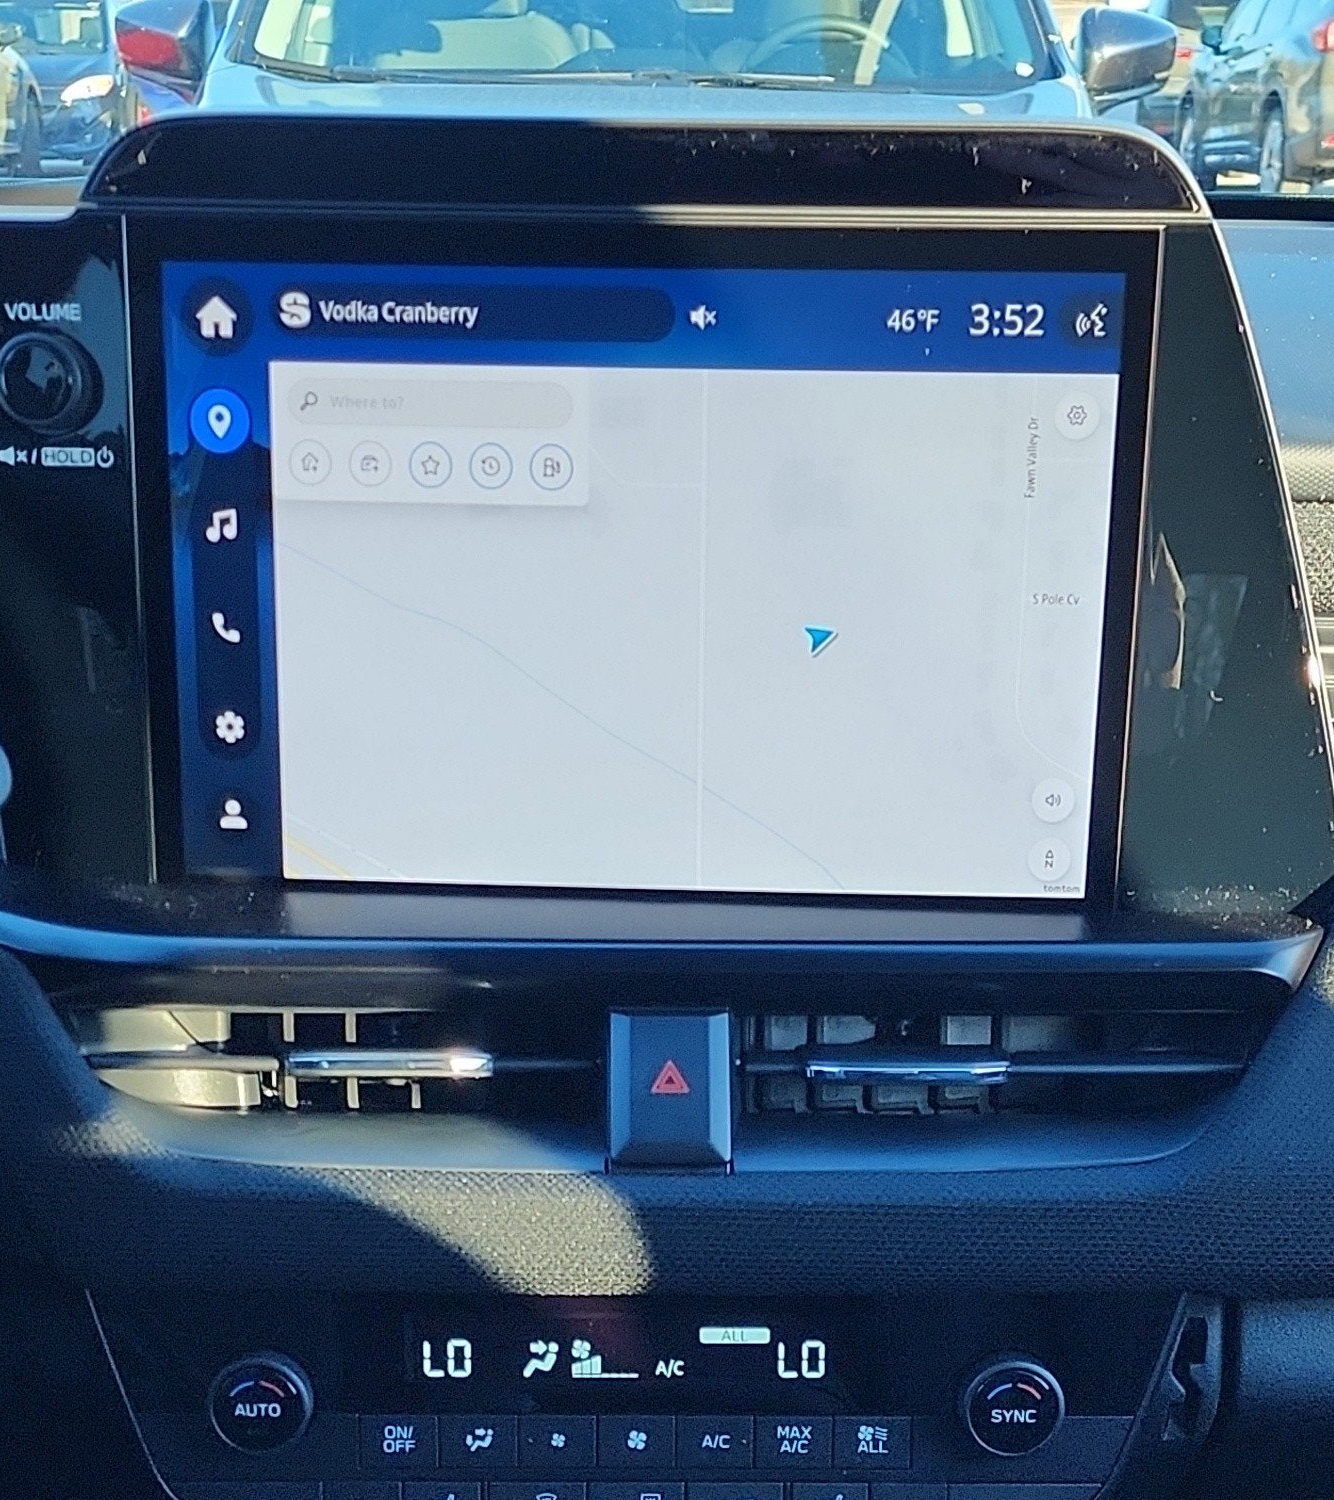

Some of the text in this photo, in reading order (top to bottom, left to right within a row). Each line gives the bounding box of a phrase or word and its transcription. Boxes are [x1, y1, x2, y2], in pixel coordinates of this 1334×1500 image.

[4, 302, 82, 321] VOLUME
[318, 299, 378, 322] Vodka
[381, 301, 479, 329] Cranberry
[886, 303, 1045, 337] 46°F 3:52
[43, 450, 93, 465] HOLD
[1027, 433, 1041, 467] Valley
[1024, 469, 1036, 498] Fawn
[721, 1328, 748, 1341] ALL
[422, 1338, 472, 1378] LO
[777, 1340, 826, 1378] LO
[655, 1359, 685, 1378] A/C
[234, 1403, 281, 1417] AUTO
[990, 1409, 1037, 1423] SYNC
[384, 1426, 414, 1438] ON/
[777, 1425, 812, 1439] MAX
[383, 1440, 416, 1453] OFF
[701, 1434, 731, 1449] A/C
[779, 1440, 809, 1454] A/C
[857, 1441, 889, 1453] ALL
